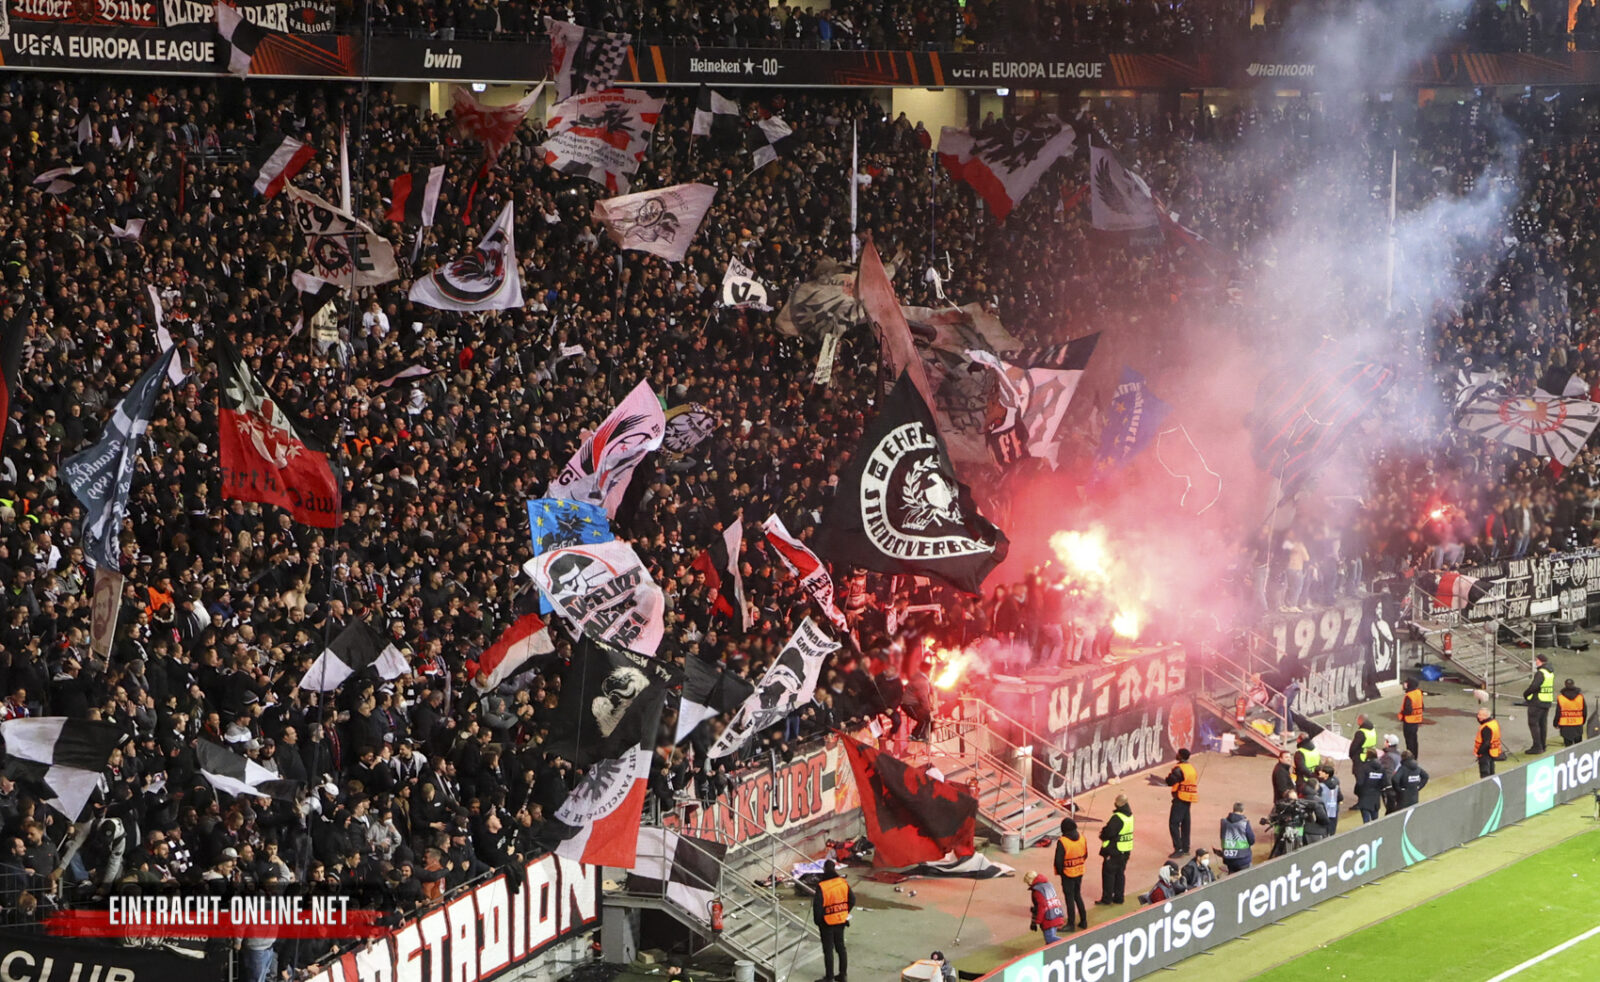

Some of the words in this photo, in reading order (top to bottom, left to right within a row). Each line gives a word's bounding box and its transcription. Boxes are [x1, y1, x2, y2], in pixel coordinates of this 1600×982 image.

[13, 33, 65, 56] UEFA
[69, 36, 141, 60] EUROPA
[145, 39, 215, 63] LEAGUE
[424, 48, 462, 69] bwin
[690, 58, 741, 74] Heineken
[992, 62, 1046, 79] EUROPA
[1049, 62, 1103, 79] LEAGUE
[1272, 602, 1363, 664] 1997
[1048, 650, 1187, 733] ULTRAS
[1047, 706, 1164, 799] Eintracht
[1223, 849, 1238, 857] 037
[1237, 837, 1383, 924] rent-a-car
